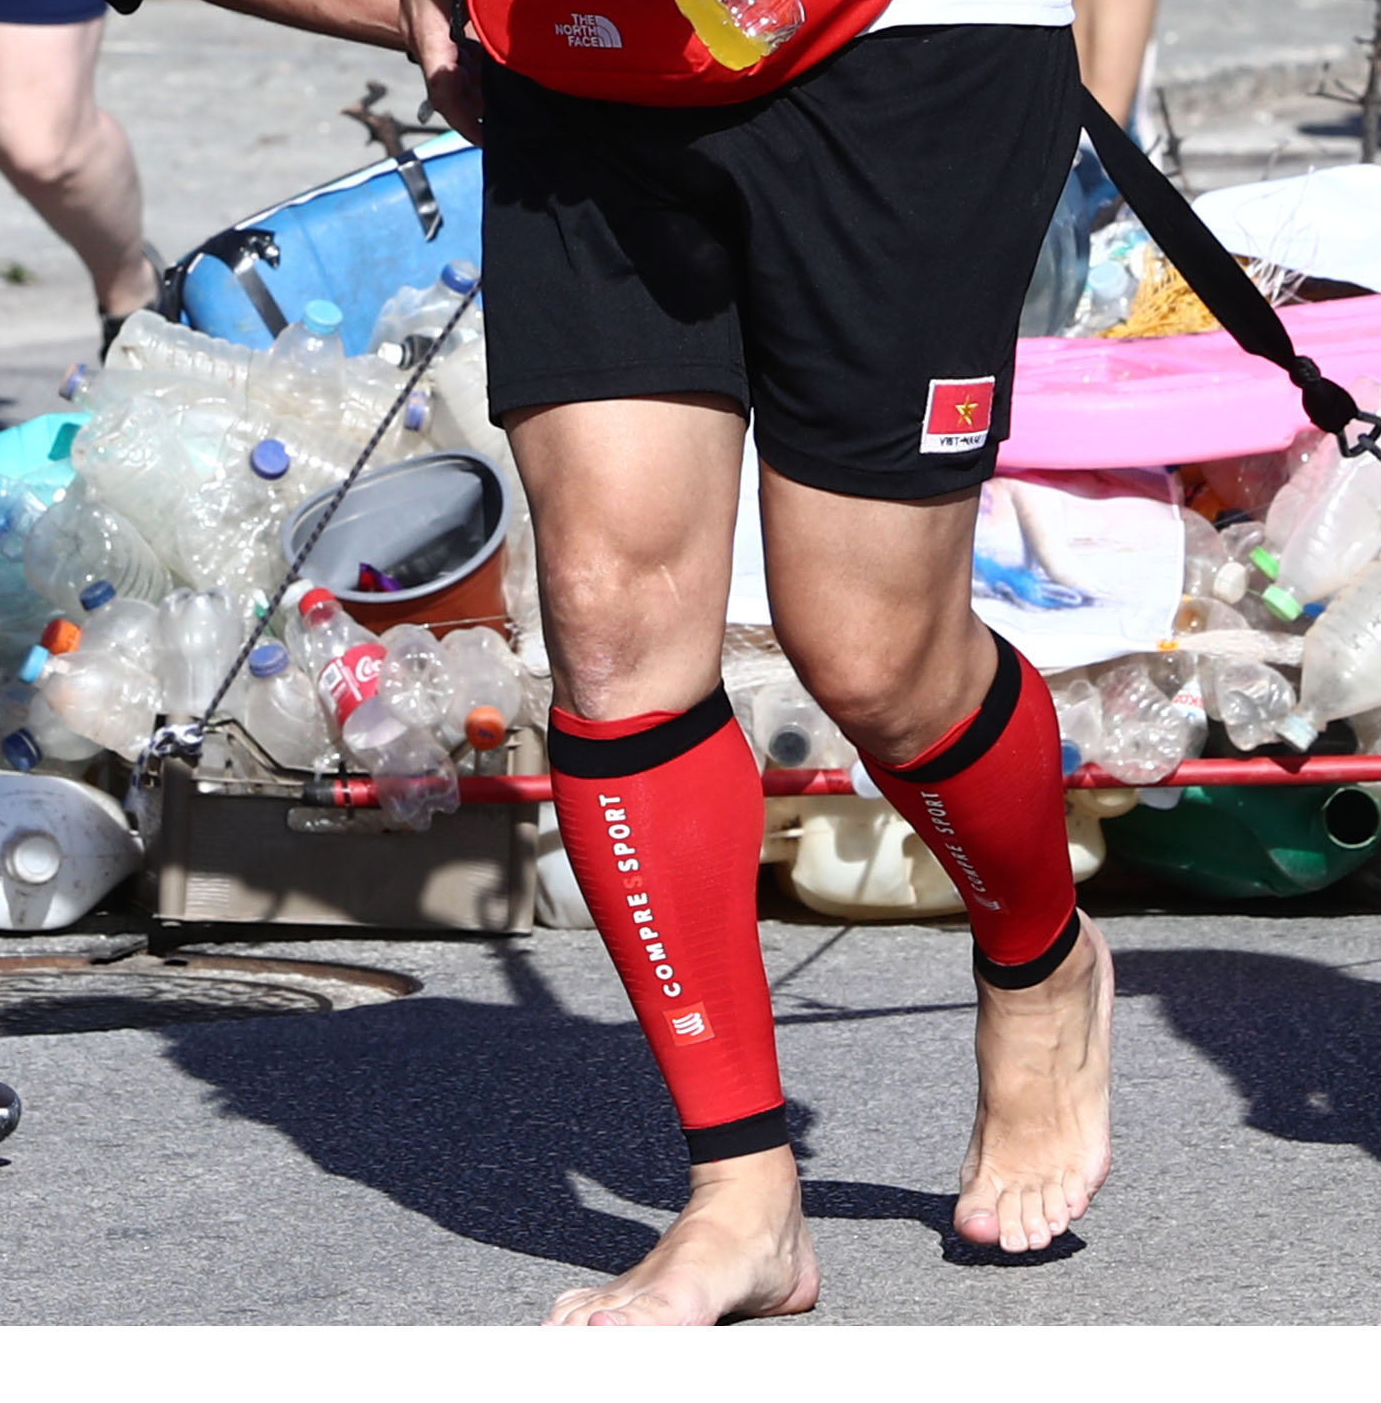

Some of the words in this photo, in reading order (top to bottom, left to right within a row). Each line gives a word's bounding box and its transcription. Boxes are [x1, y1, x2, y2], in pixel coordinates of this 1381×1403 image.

[571, 13, 595, 25] THE
[555, 24, 596, 36] NORTH
[568, 36, 598, 47] FACE
